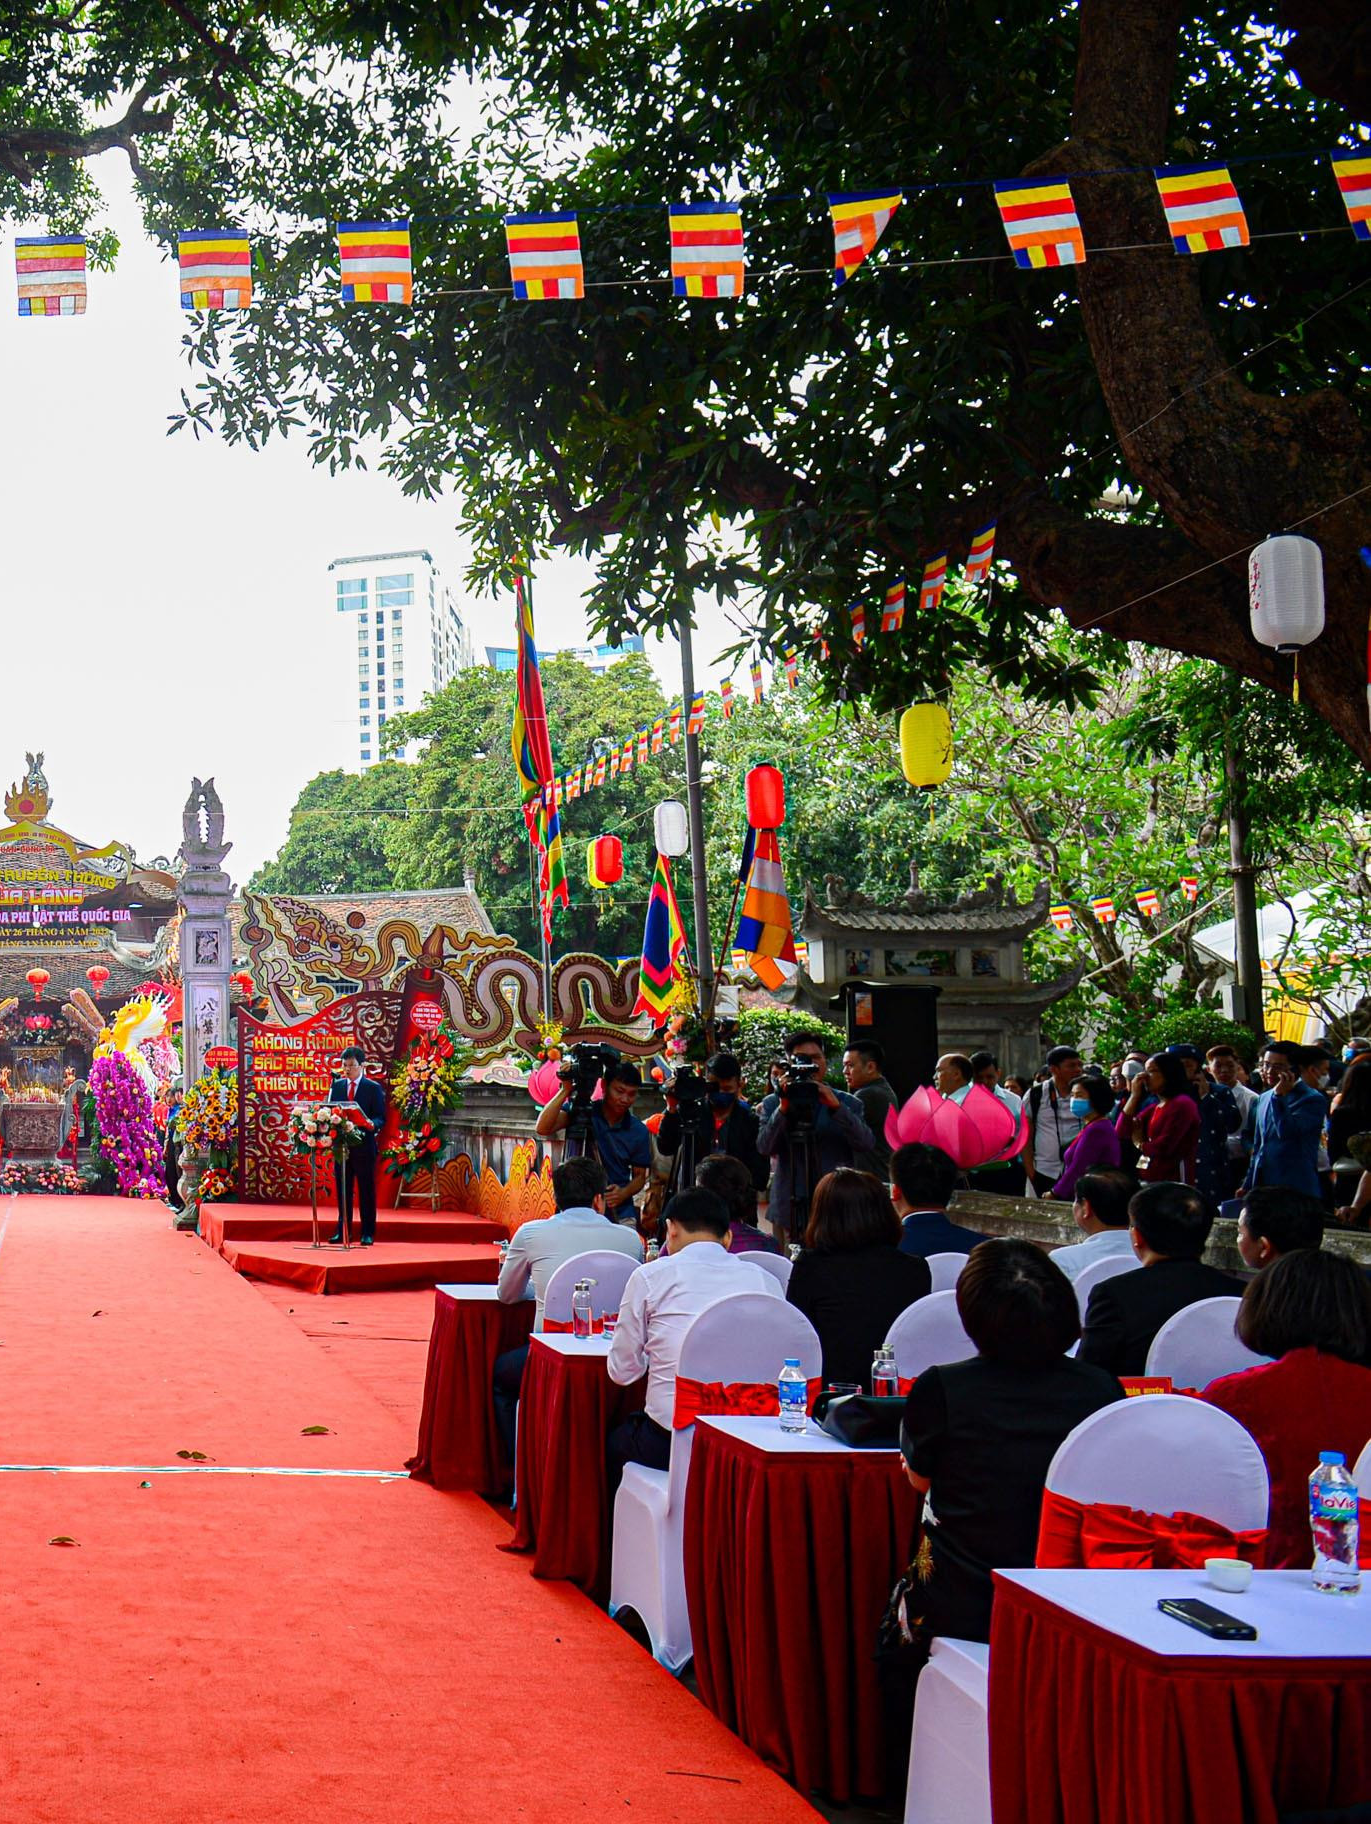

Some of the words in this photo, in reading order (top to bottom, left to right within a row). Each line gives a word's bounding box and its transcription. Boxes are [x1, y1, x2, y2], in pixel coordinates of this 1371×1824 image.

[28, 881, 84, 906] LÁNG
[11, 911, 31, 924] PHI
[32, 909, 54, 926] VẬT
[57, 906, 80, 922] THỂ
[81, 906, 110, 925] QUỐC
[112, 909, 132, 922] GIA
